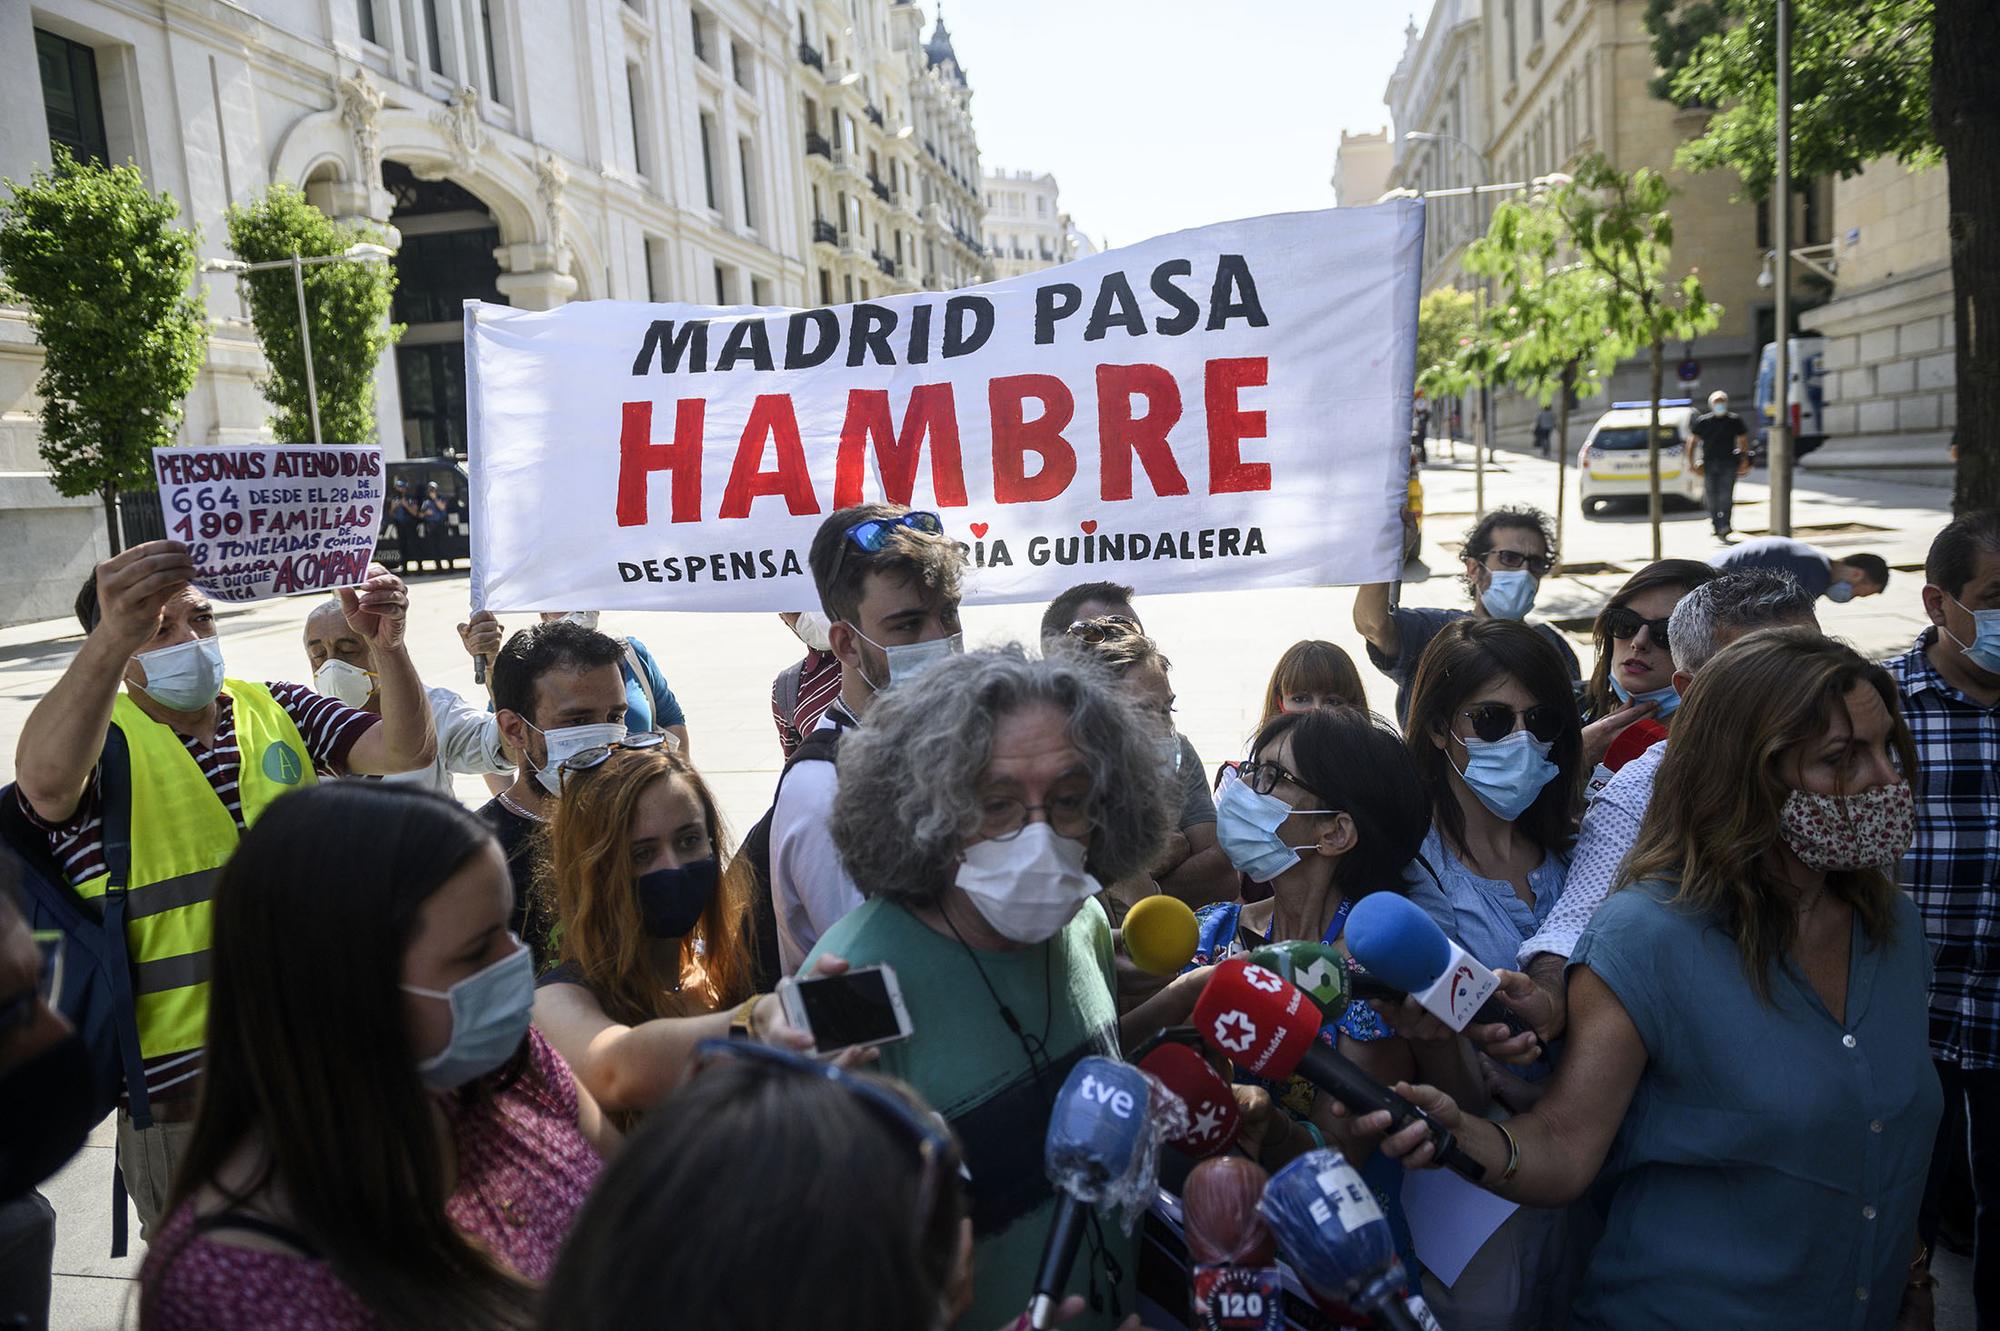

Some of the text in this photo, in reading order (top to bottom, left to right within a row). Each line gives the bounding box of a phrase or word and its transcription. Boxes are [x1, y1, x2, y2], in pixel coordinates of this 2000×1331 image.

[632, 254, 1269, 376] MADRID PASA
[616, 356, 1272, 527] HAMBRE
[157, 452, 381, 485] PERSONAS ATENDIDAS
[357, 479, 370, 489] DE
[171, 486, 381, 514] 664 DESDE EL 28 ABRIL
[173, 511, 244, 542] 190
[338, 526, 352, 537] DE
[216, 532, 322, 560] TONELADAS
[617, 548, 803, 583] DESPENSA
[1027, 527, 1267, 568] GUINDALERA
[223, 571, 272, 588] DUQUE
[1081, 1074, 1134, 1118] tve
[1218, 1292, 1263, 1318] 120
